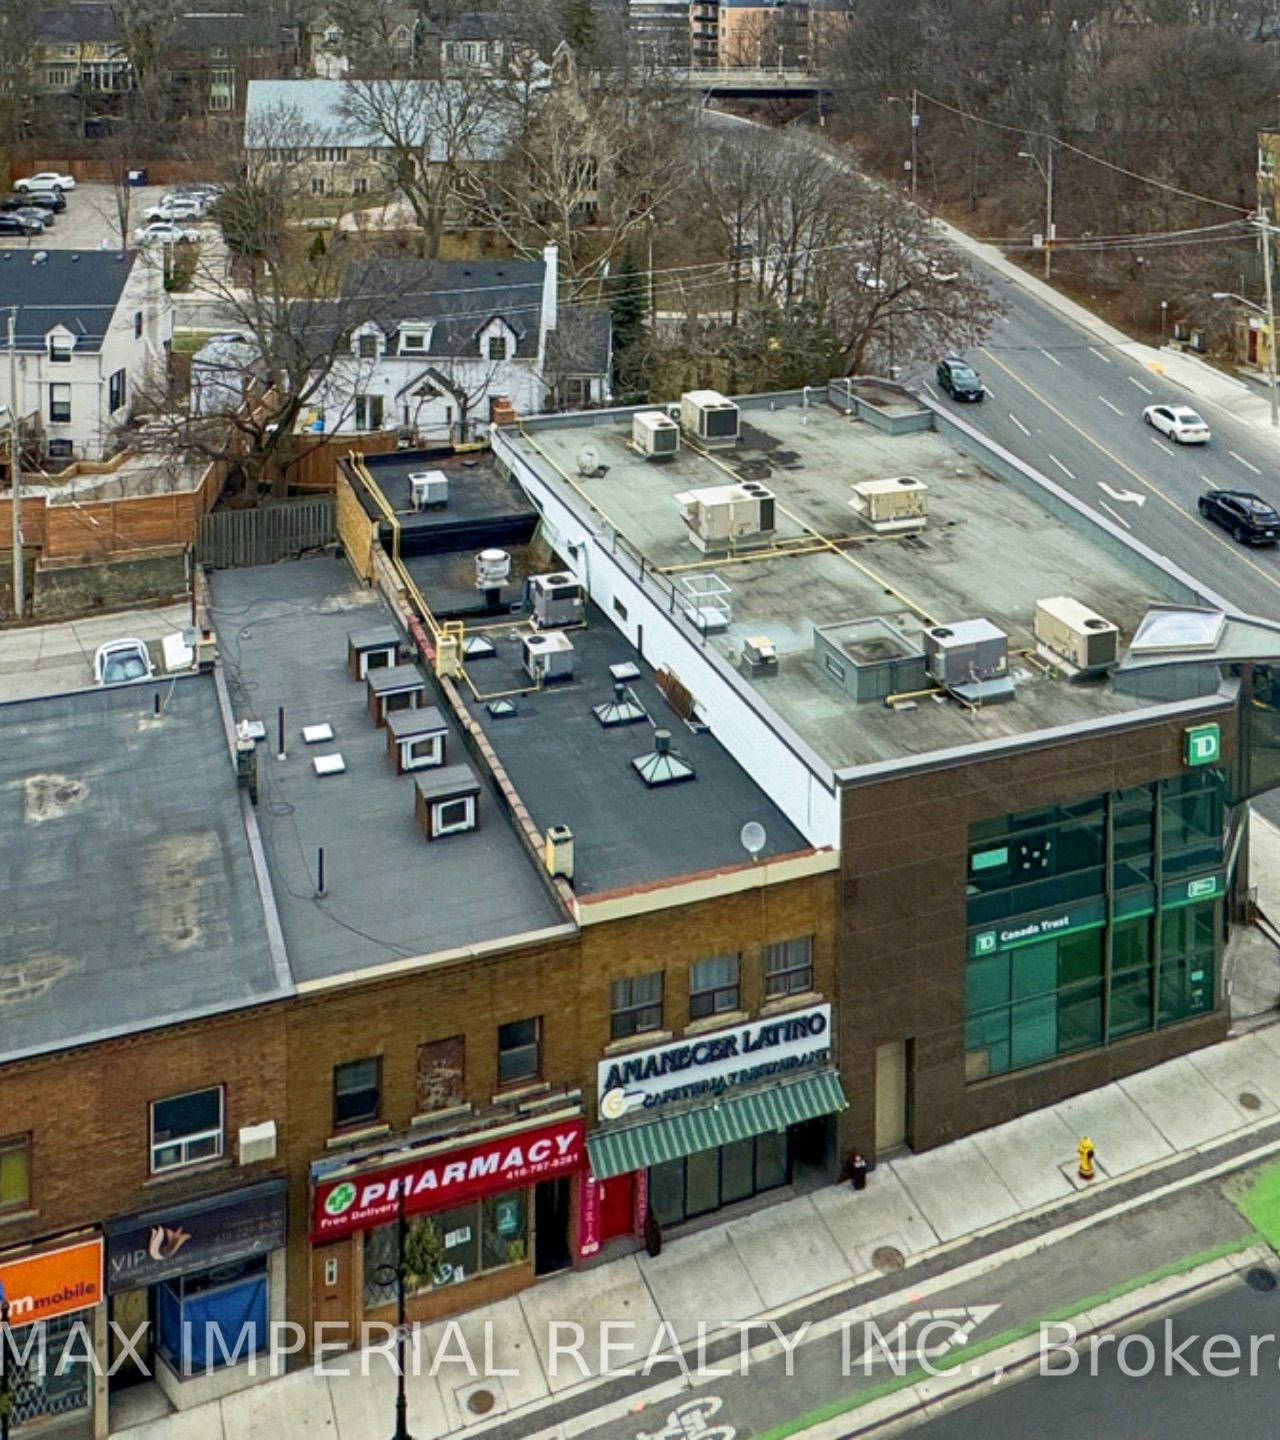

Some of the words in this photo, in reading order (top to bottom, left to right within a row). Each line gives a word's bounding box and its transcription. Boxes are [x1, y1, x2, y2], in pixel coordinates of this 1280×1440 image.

[1193, 734, 1217, 758] TD
[978, 934, 995, 952] TD
[1000, 923, 1040, 942] Canada
[1041, 915, 1070, 931] Trust
[605, 1034, 739, 1090] AMANECER
[743, 1012, 827, 1055] LATINO
[359, 1130, 578, 1209] PHARMACY
[321, 1216, 348, 1229] Free
[351, 1200, 400, 1221] Delivery
[111, 1249, 147, 1271] VIP
[34, 1281, 96, 1310] mobile
